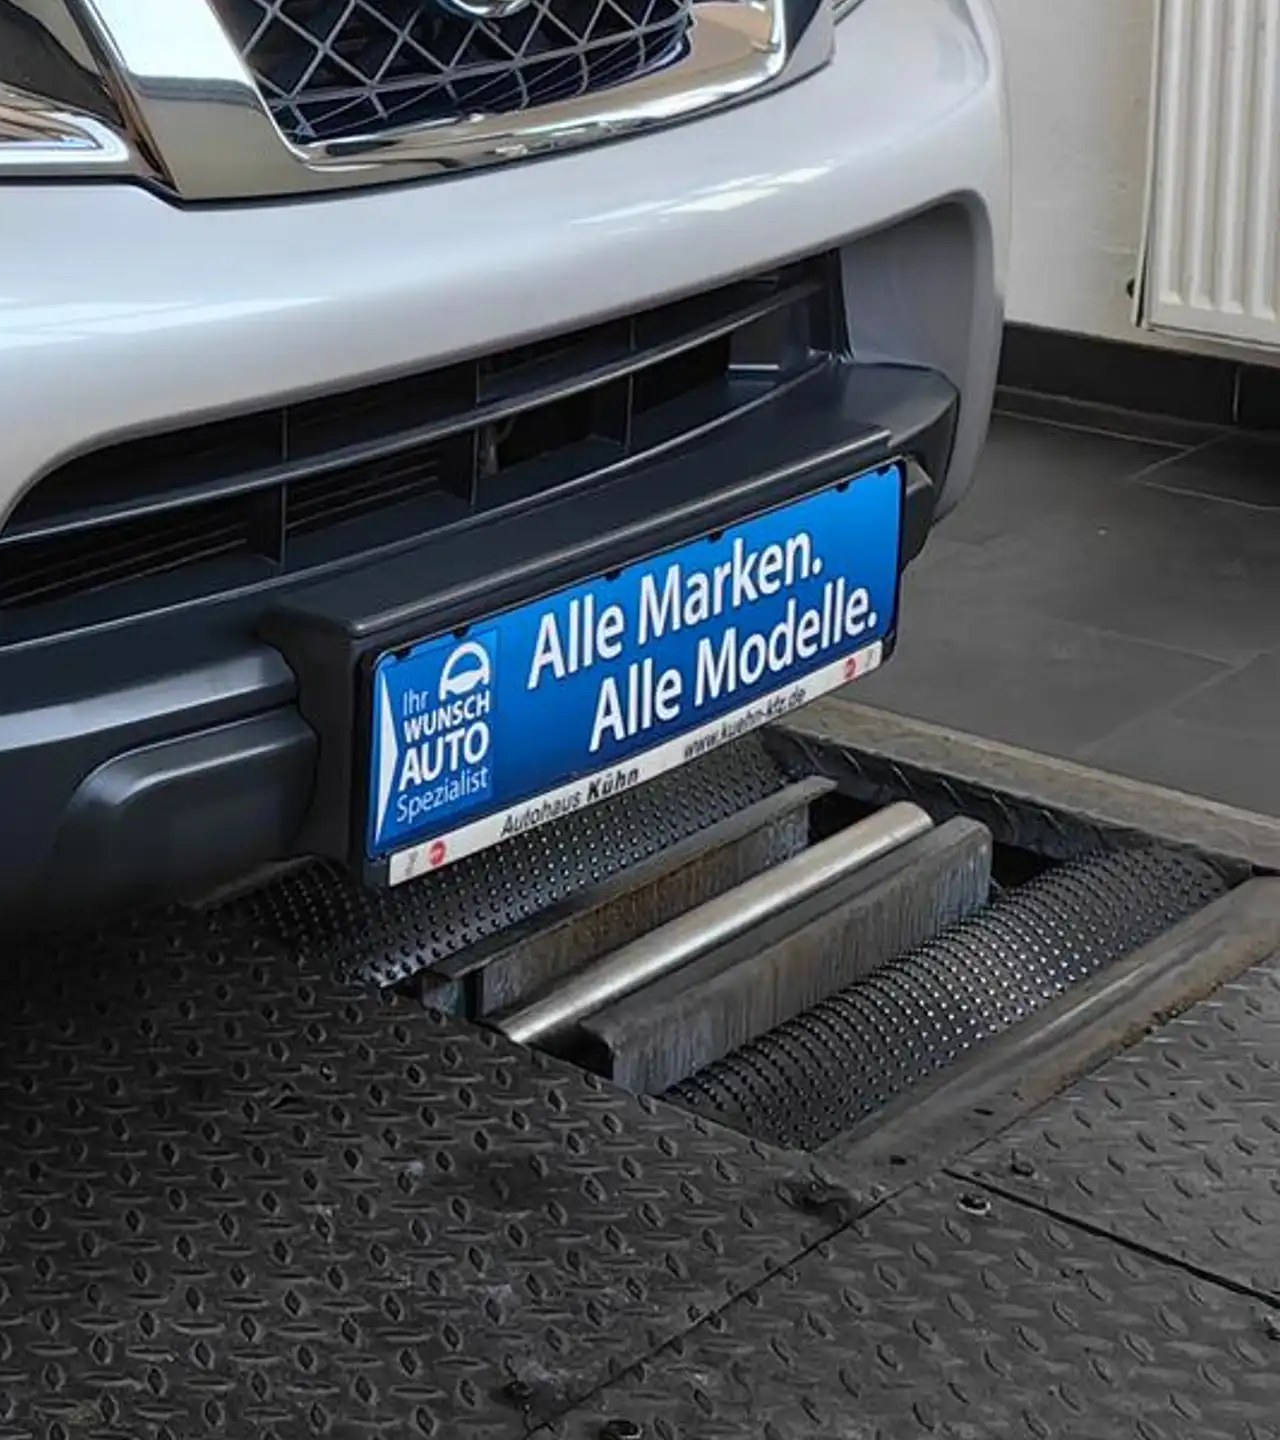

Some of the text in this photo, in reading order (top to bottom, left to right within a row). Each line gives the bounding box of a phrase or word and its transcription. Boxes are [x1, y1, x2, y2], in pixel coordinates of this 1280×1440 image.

[526, 530, 824, 691] Alle Marken.
[588, 576, 878, 753] Alle Modelle.
[403, 688, 429, 716] Ihr
[403, 689, 491, 743] WUNSCH
[398, 721, 491, 793] AUTO
[499, 686, 807, 838] Autohaus Kühn www.kuehn-kfz.de
[395, 766, 489, 824] Spezialist
